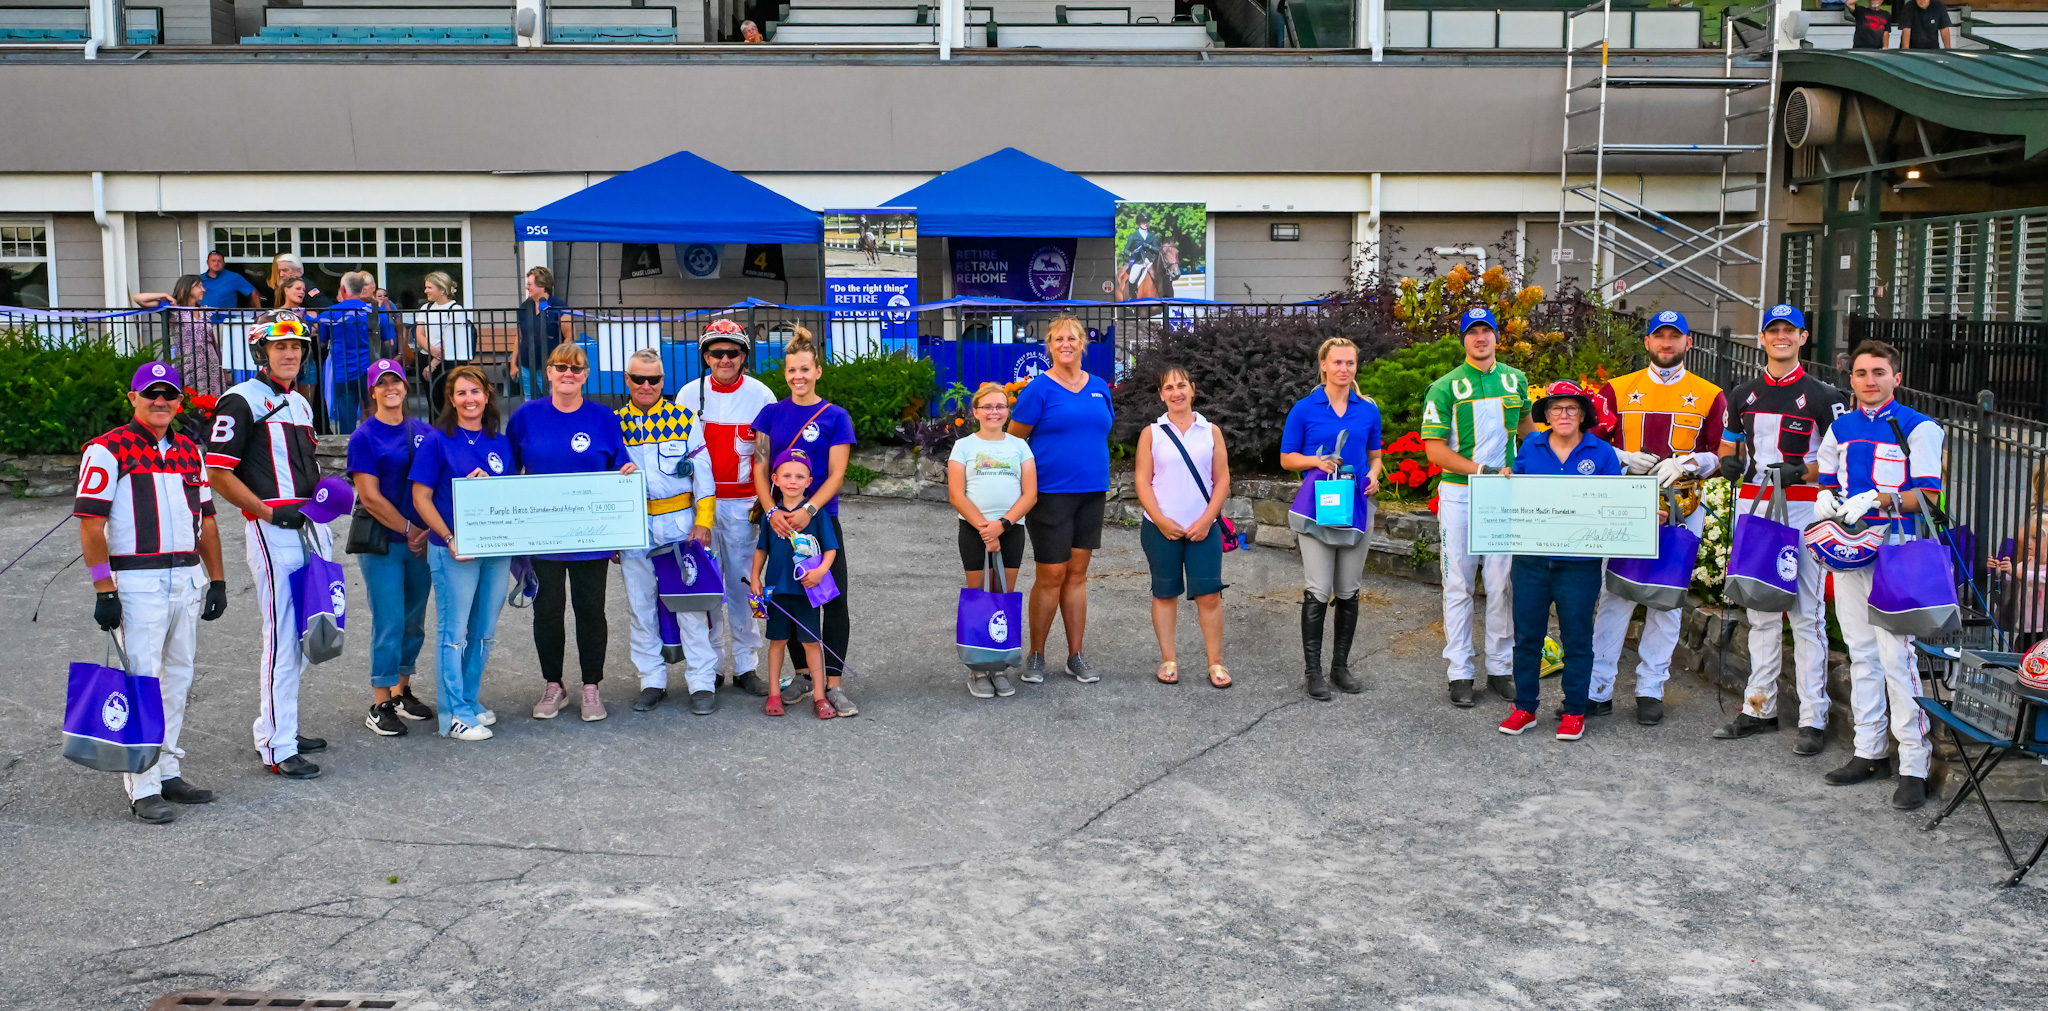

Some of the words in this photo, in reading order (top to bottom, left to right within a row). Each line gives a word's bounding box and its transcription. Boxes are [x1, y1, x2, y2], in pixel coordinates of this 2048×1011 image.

[526, 225, 549, 235] DSG
[637, 250, 650, 269] 4
[753, 251, 767, 270] 4
[956, 250, 998, 260] RETIRE
[956, 261, 1009, 272] RETRAIN
[956, 273, 1008, 284] REHOME
[848, 284, 861, 292] the
[862, 284, 882, 294] right
[834, 294, 878, 304] RETIRE
[1422, 400, 1442, 424] A
[210, 415, 236, 442] B
[490, 506, 510, 516] Purple
[512, 506, 528, 514] Haze
